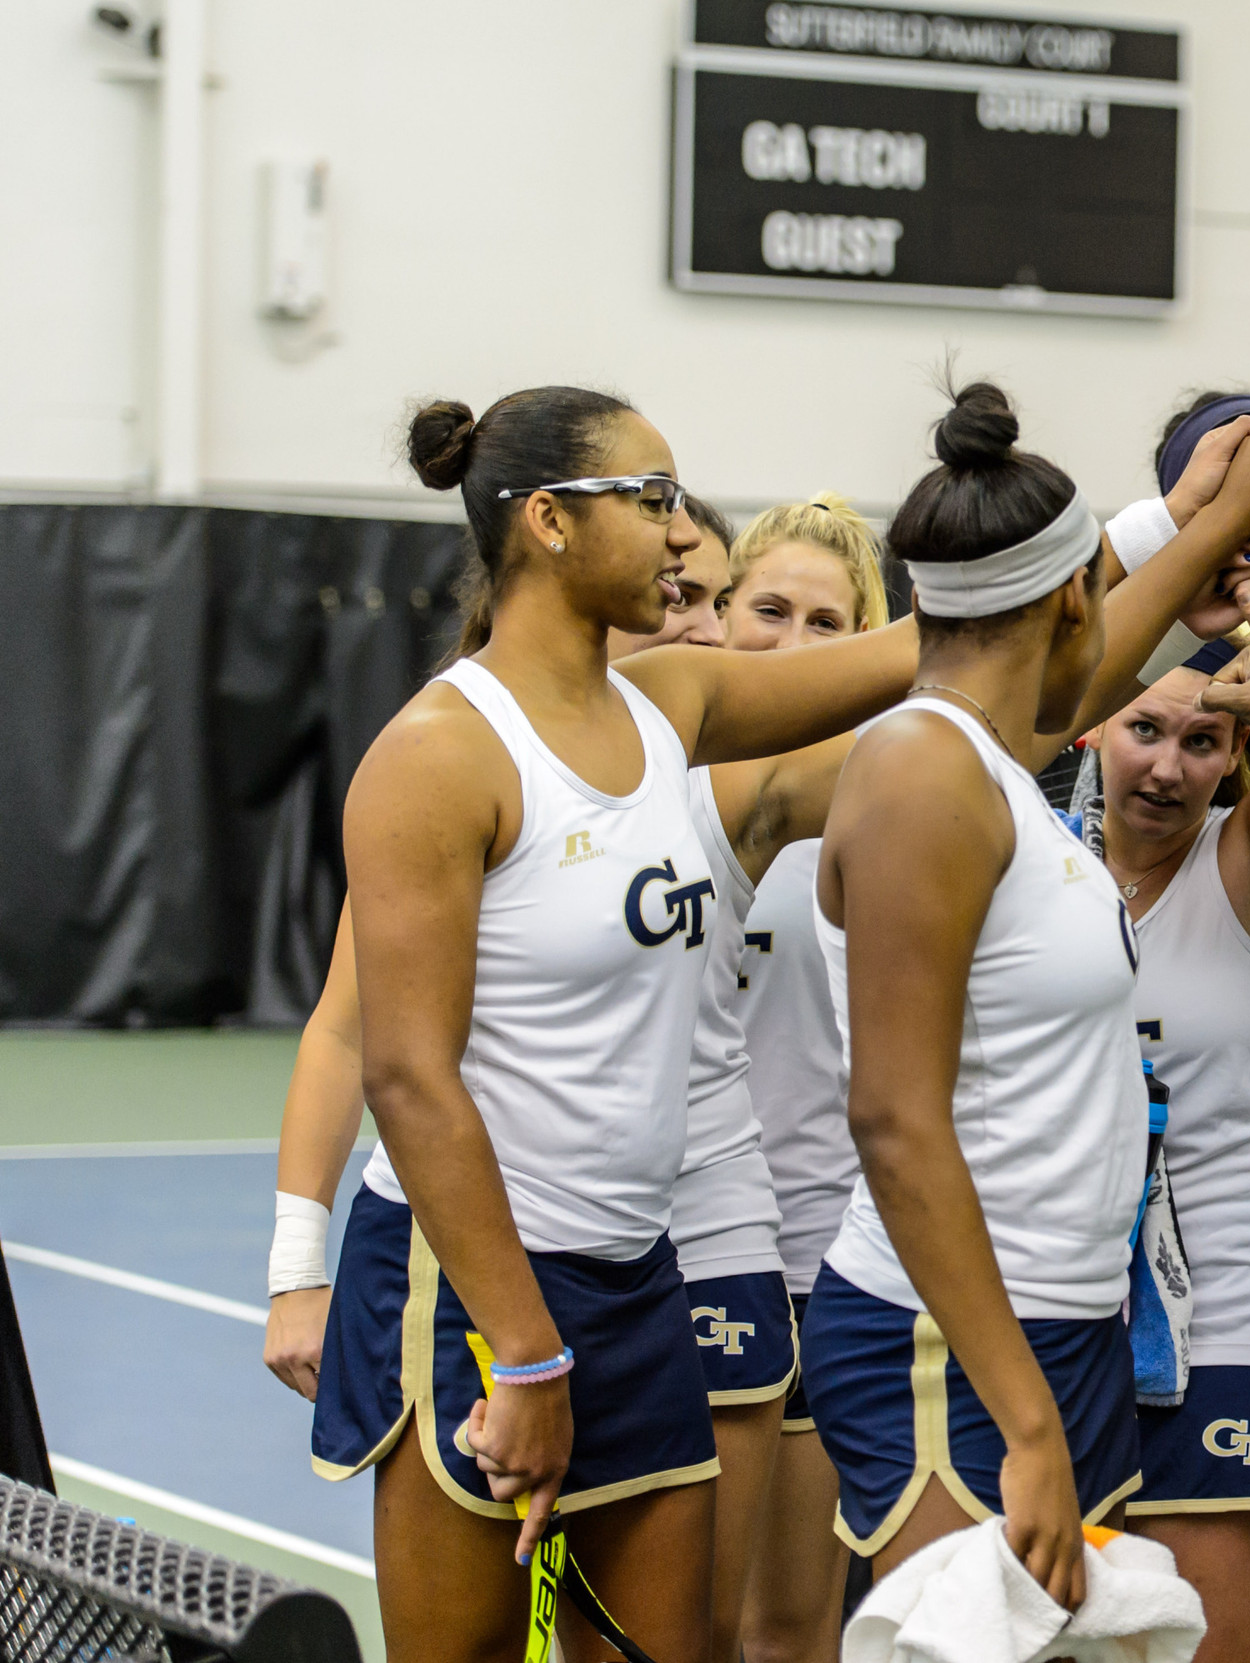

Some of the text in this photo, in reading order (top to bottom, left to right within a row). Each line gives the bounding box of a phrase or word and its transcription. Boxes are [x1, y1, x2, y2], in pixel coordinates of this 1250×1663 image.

[1025, 24, 1115, 72] COURT
[977, 85, 1088, 136] COURT
[742, 119, 927, 190] GA TECH
[761, 209, 903, 276] GUEST
[558, 847, 607, 869] RUSSELL
[622, 856, 718, 952] GT
[690, 1306, 755, 1355] GT
